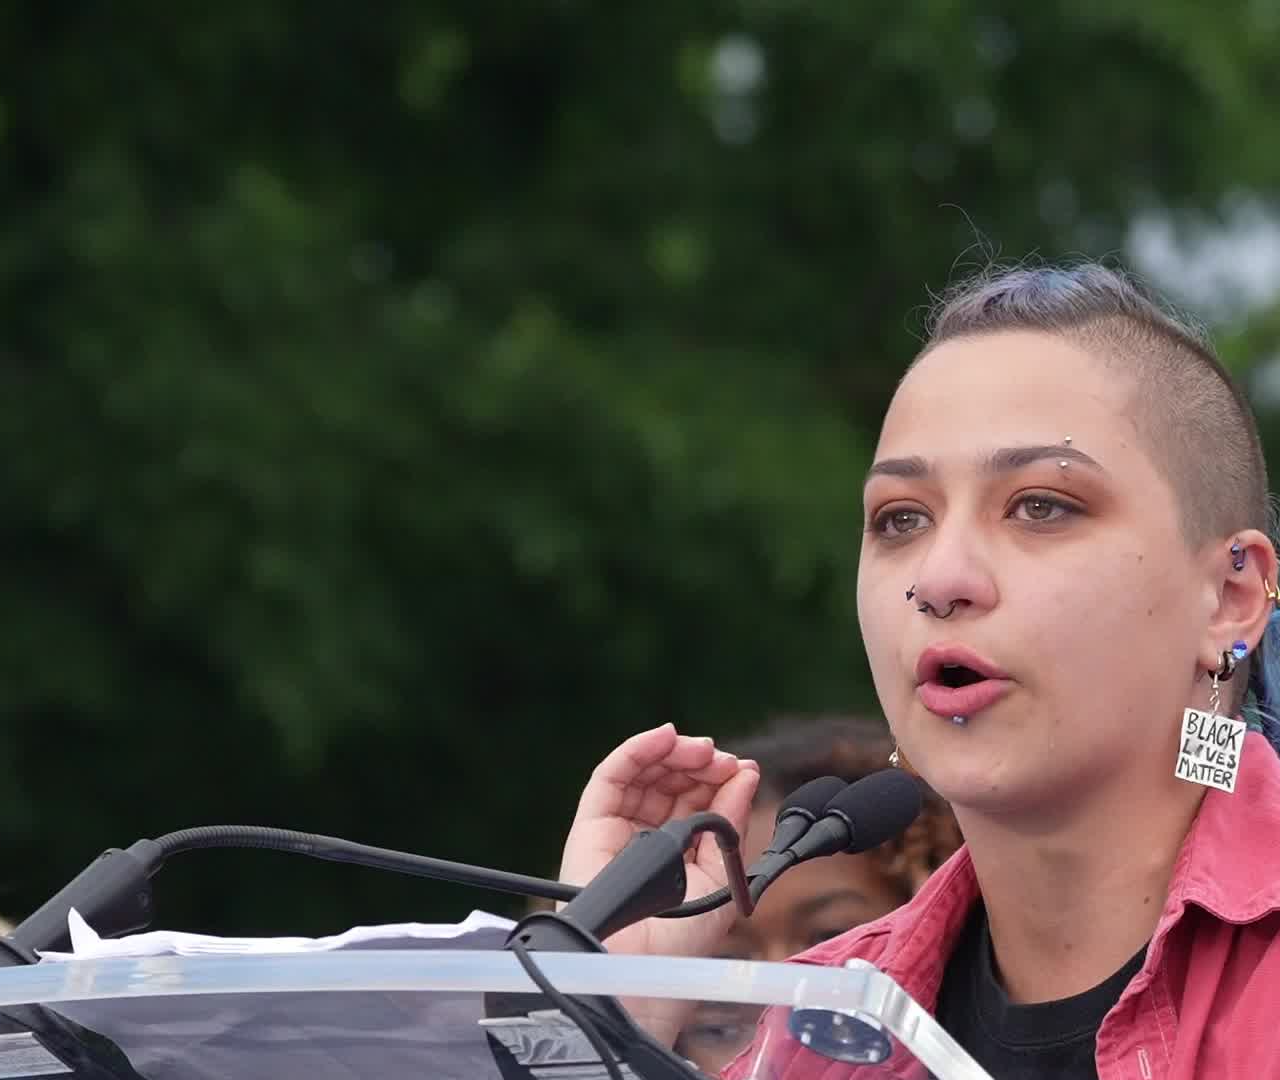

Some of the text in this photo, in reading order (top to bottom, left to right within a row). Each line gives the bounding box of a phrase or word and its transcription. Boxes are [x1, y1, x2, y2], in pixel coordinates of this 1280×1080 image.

[1186, 711, 1243, 751] BLACK
[1182, 738, 1237, 769] LIVES
[1177, 757, 1234, 788] MATTER
